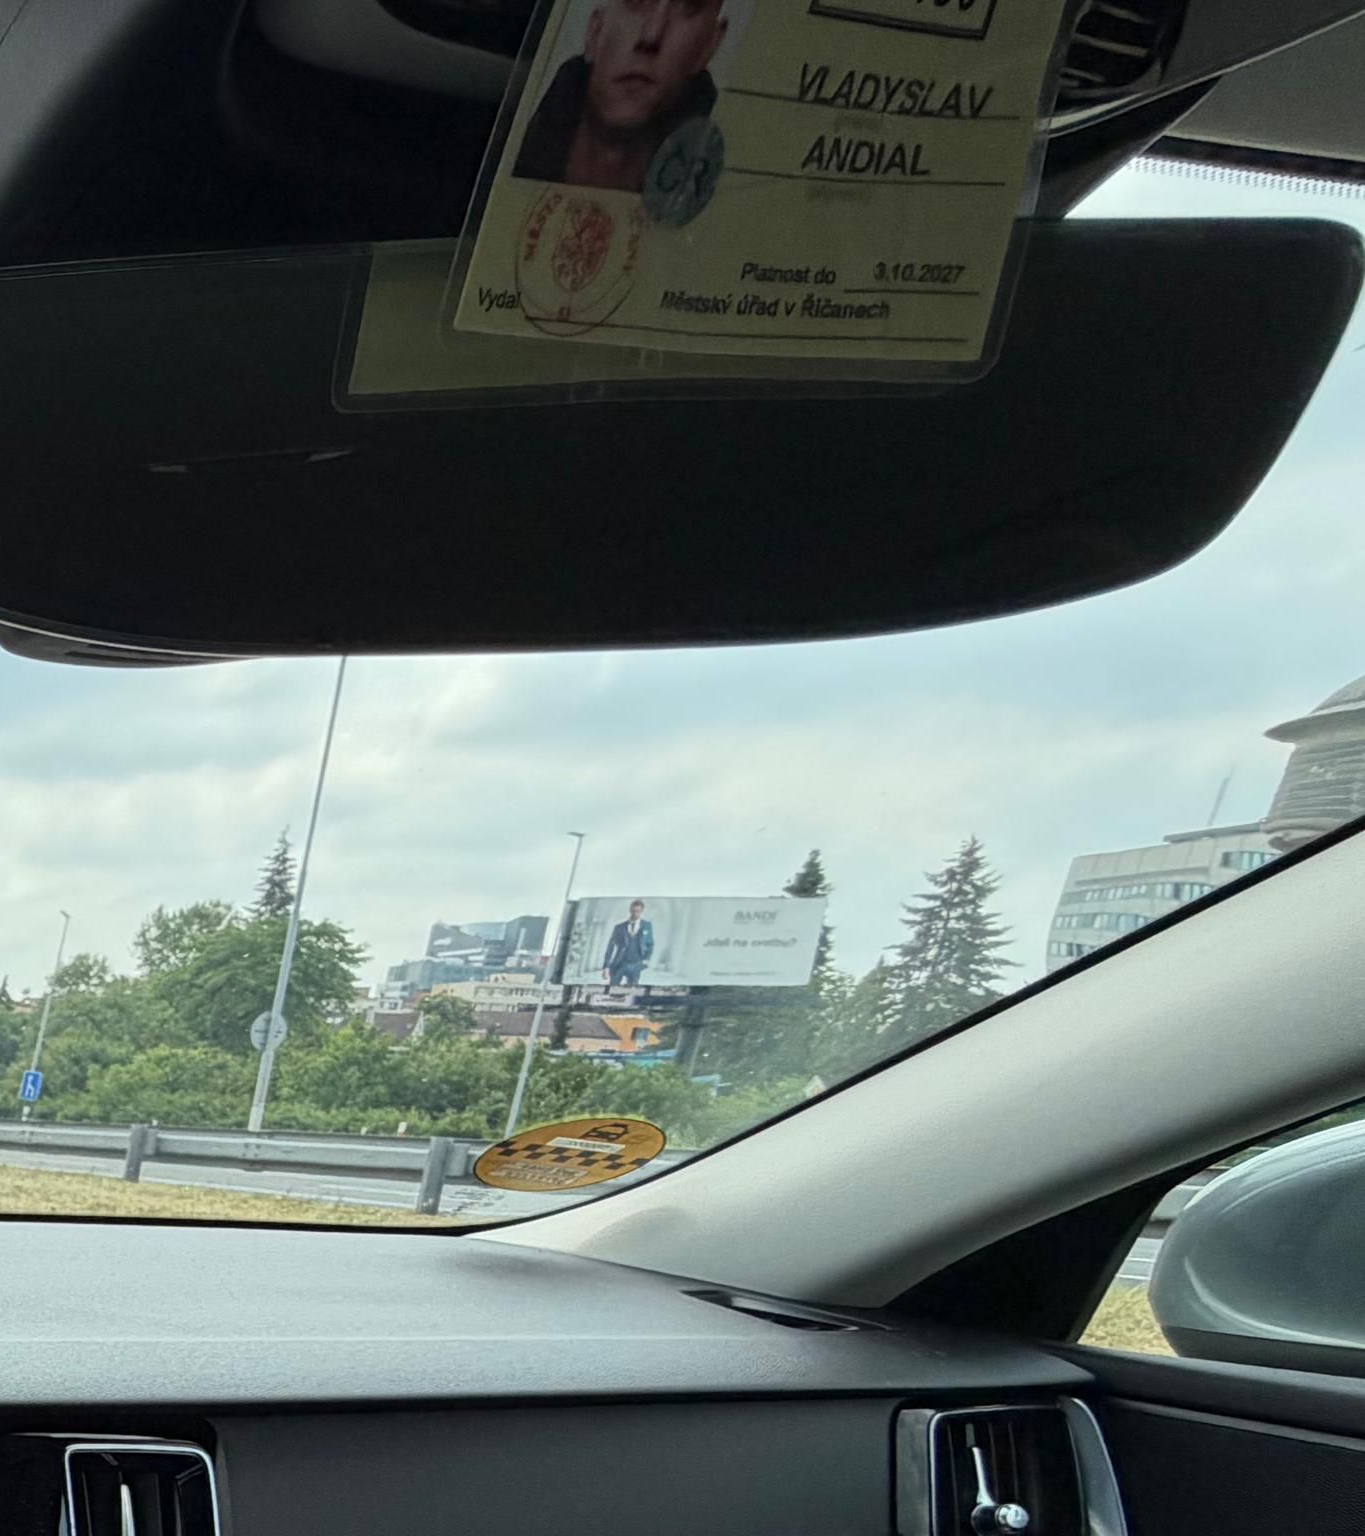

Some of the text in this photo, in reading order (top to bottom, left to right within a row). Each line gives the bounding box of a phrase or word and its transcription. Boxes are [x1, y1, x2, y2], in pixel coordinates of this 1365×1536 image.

[798, 62, 994, 118] VLADYSLAV
[800, 135, 931, 177] ANDIAL
[740, 262, 812, 284] Platnost
[813, 265, 837, 285] do
[477, 286, 522, 312] Vydal
[735, 291, 777, 317] úřad
[783, 300, 797, 316] v
